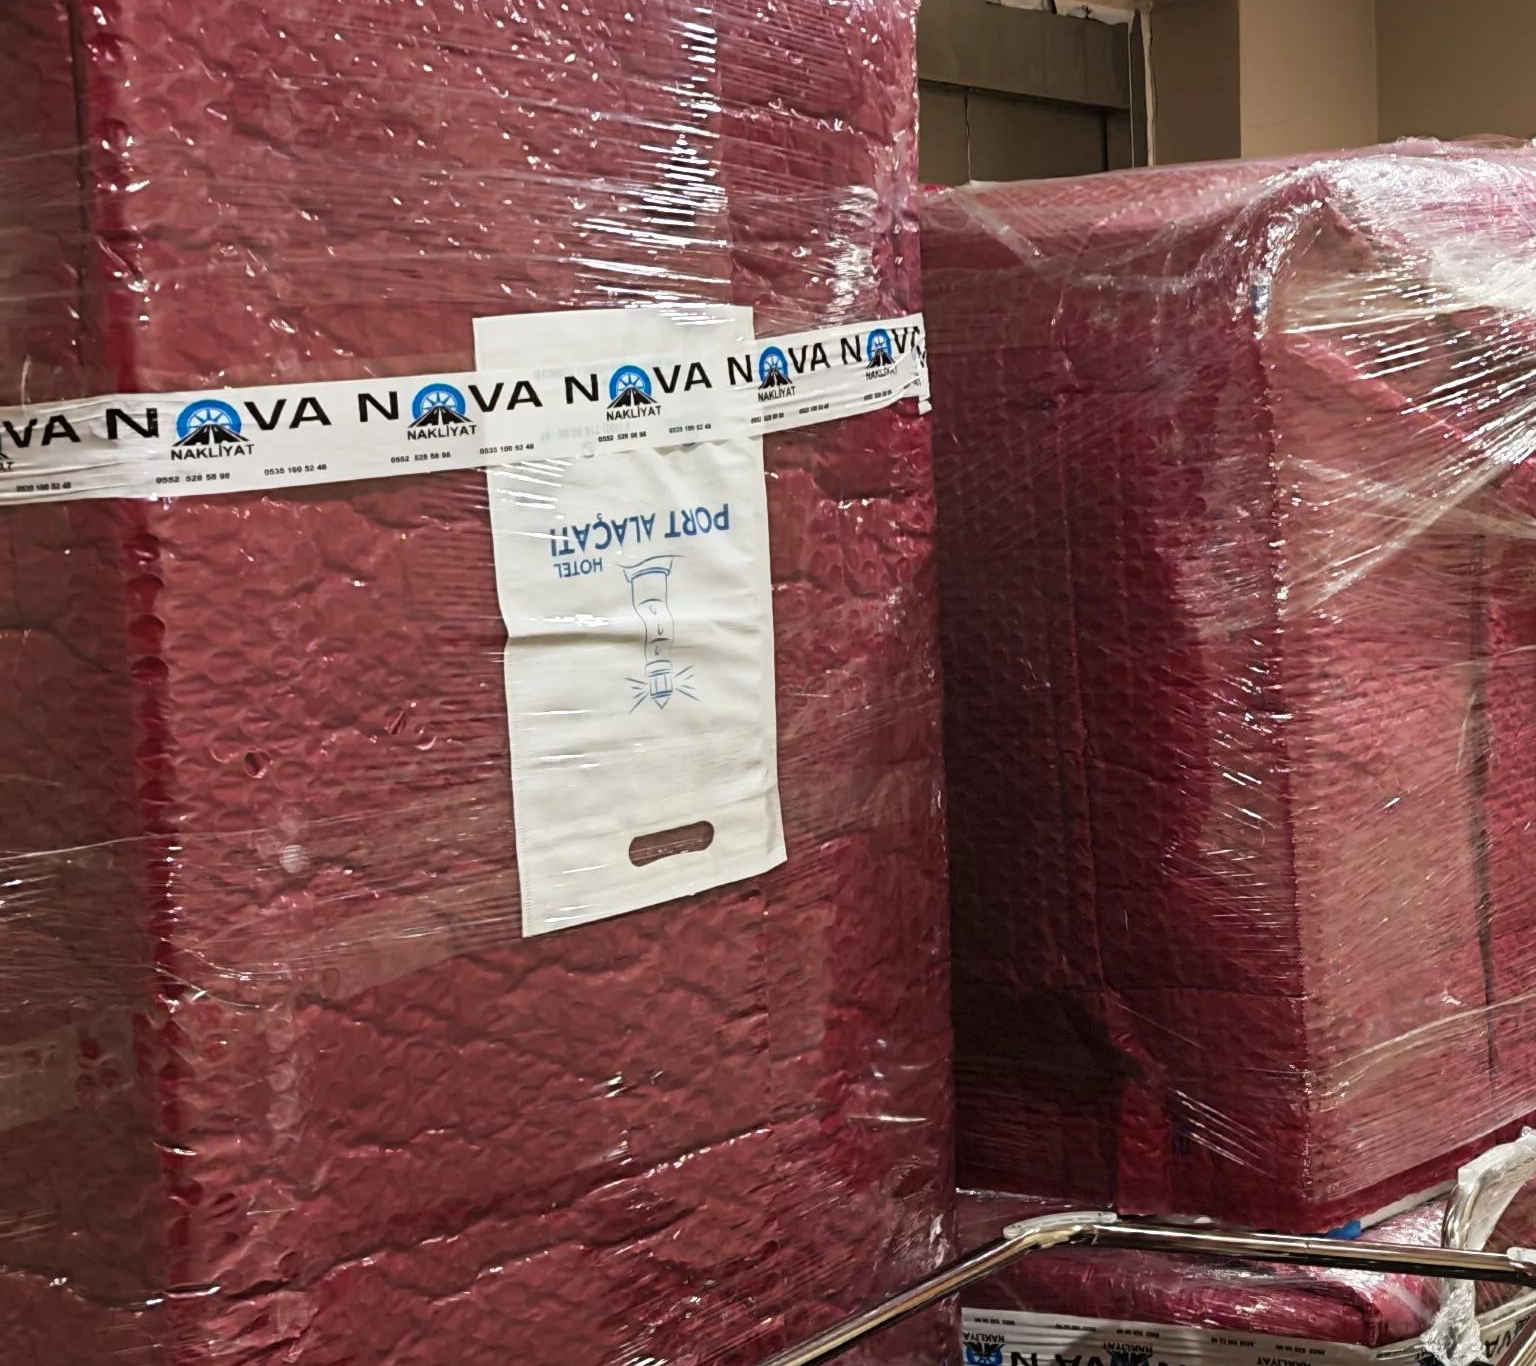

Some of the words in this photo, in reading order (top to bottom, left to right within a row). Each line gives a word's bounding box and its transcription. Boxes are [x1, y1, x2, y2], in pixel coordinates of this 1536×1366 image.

[0, 414, 81, 448] VA
[106, 396, 332, 446] NOVA
[357, 383, 543, 427] NOVA
[565, 362, 713, 409] NOVA
[727, 341, 832, 389] NOVA
[606, 404, 662, 421] NAKLİYAT
[407, 423, 478, 441] NAKLİYAT
[170, 442, 255, 461] NAKLİYAT
[665, 503, 730, 540] PORT
[550, 512, 656, 556] ALAÇATI
[553, 557, 603, 579] HOTEL
[963, 1331, 1006, 1343] NAKLİYA
